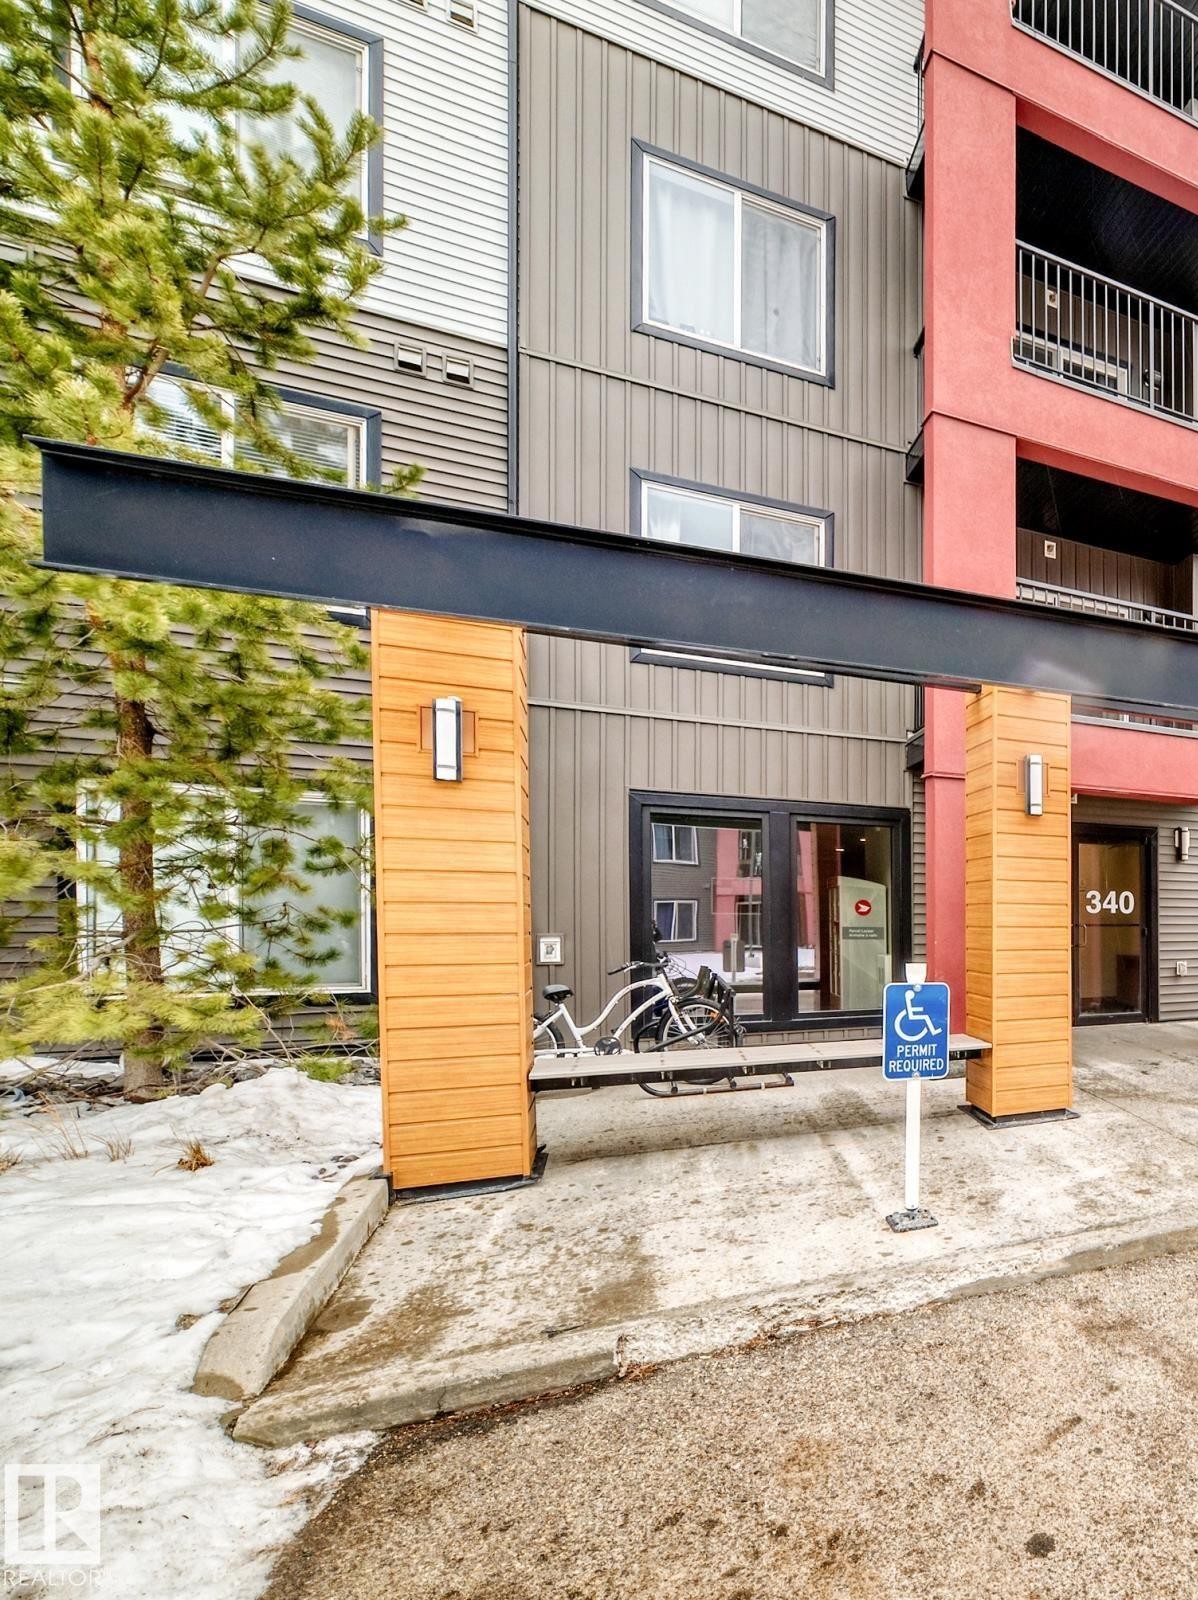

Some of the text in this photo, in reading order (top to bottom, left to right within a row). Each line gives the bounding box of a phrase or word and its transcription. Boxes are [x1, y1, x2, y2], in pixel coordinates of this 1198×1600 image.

[1085, 890, 1135, 915] 340
[896, 1044, 938, 1057] PERMIT
[888, 1058, 944, 1072] REQUIRED
